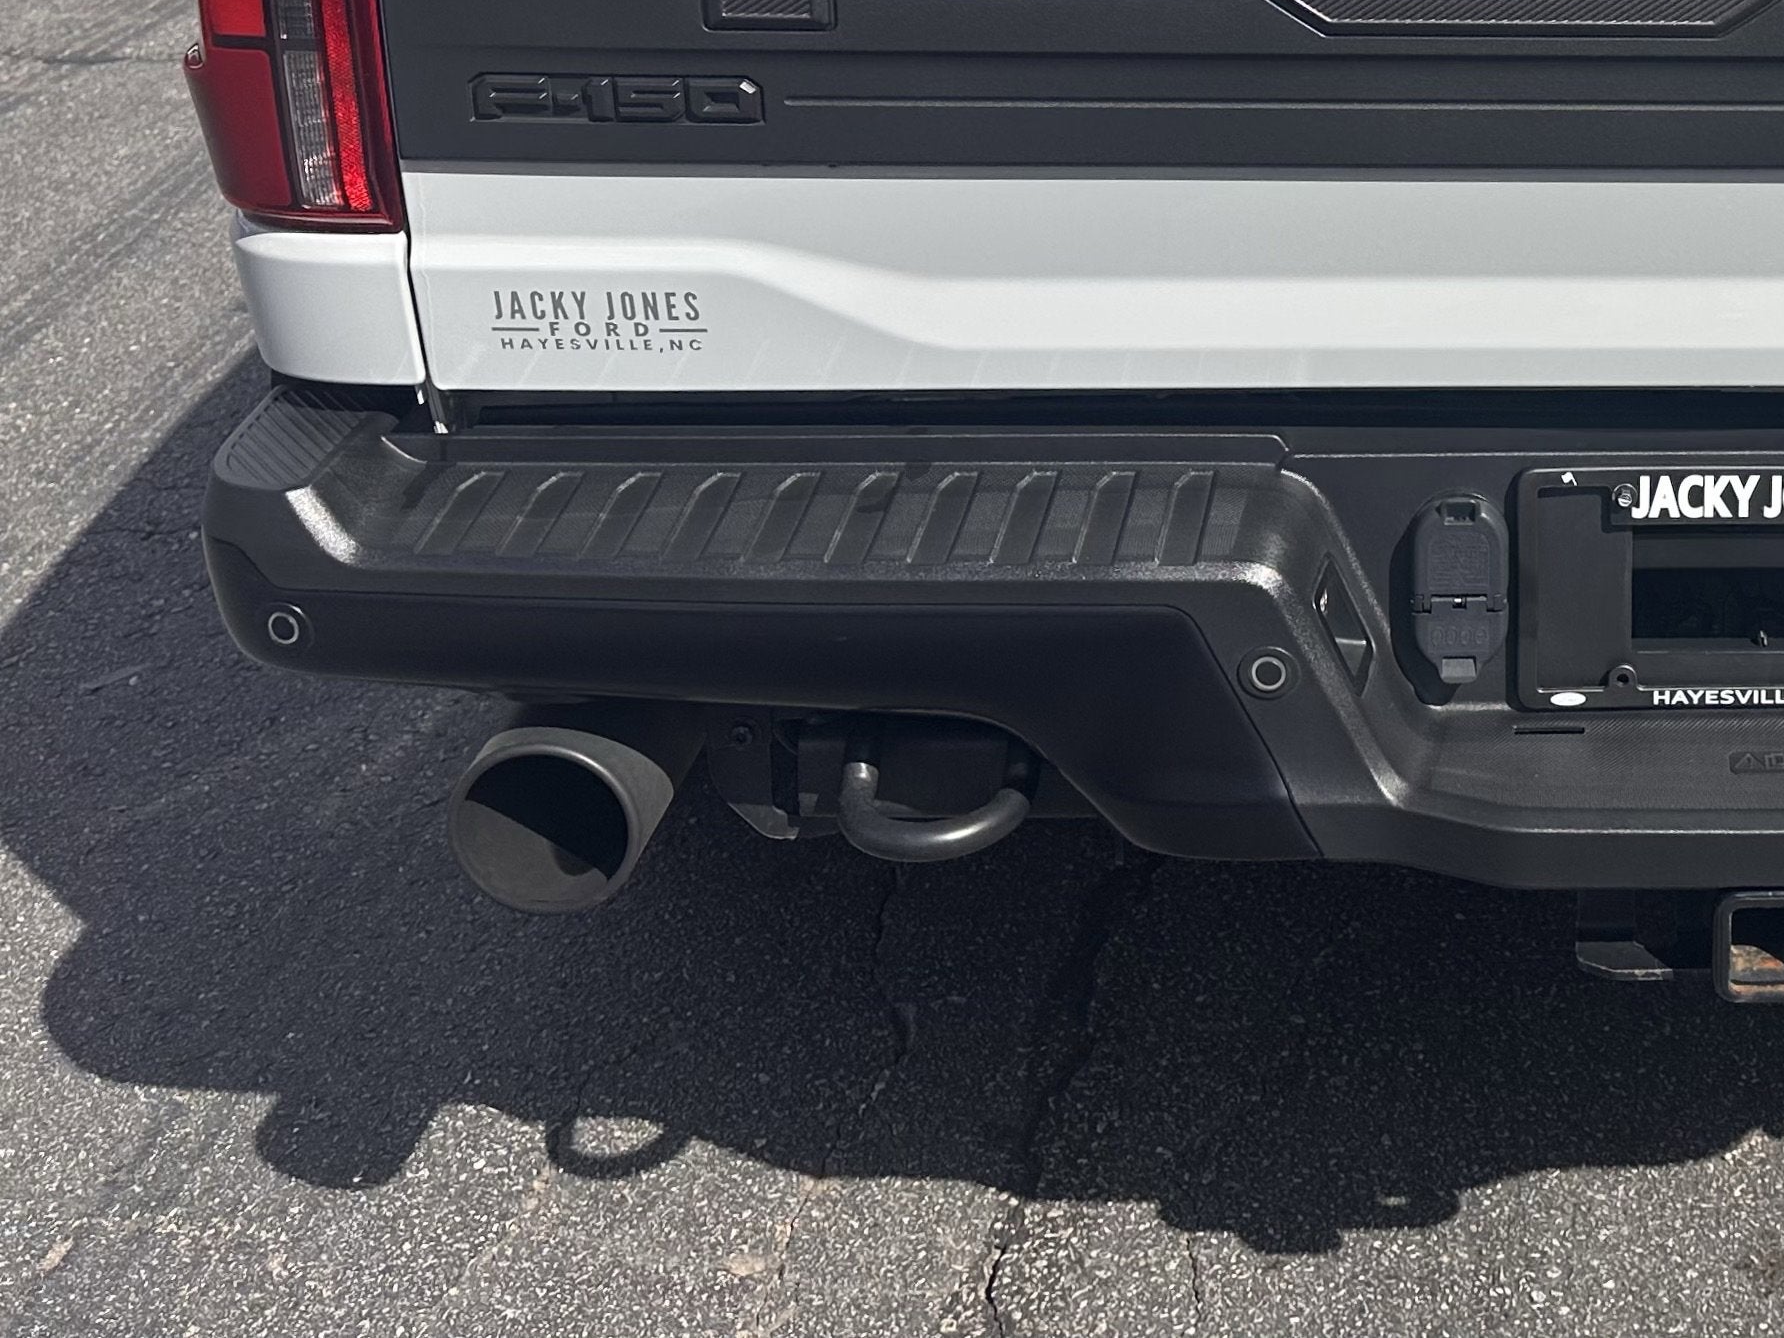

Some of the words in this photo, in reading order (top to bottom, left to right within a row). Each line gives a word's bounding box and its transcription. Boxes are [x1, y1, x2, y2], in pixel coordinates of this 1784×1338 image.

[469, 72, 766, 125] F-150
[493, 290, 587, 321] JACKY
[605, 291, 701, 322] JONES
[549, 321, 650, 338] FORD
[1631, 474, 1760, 520] JACKY
